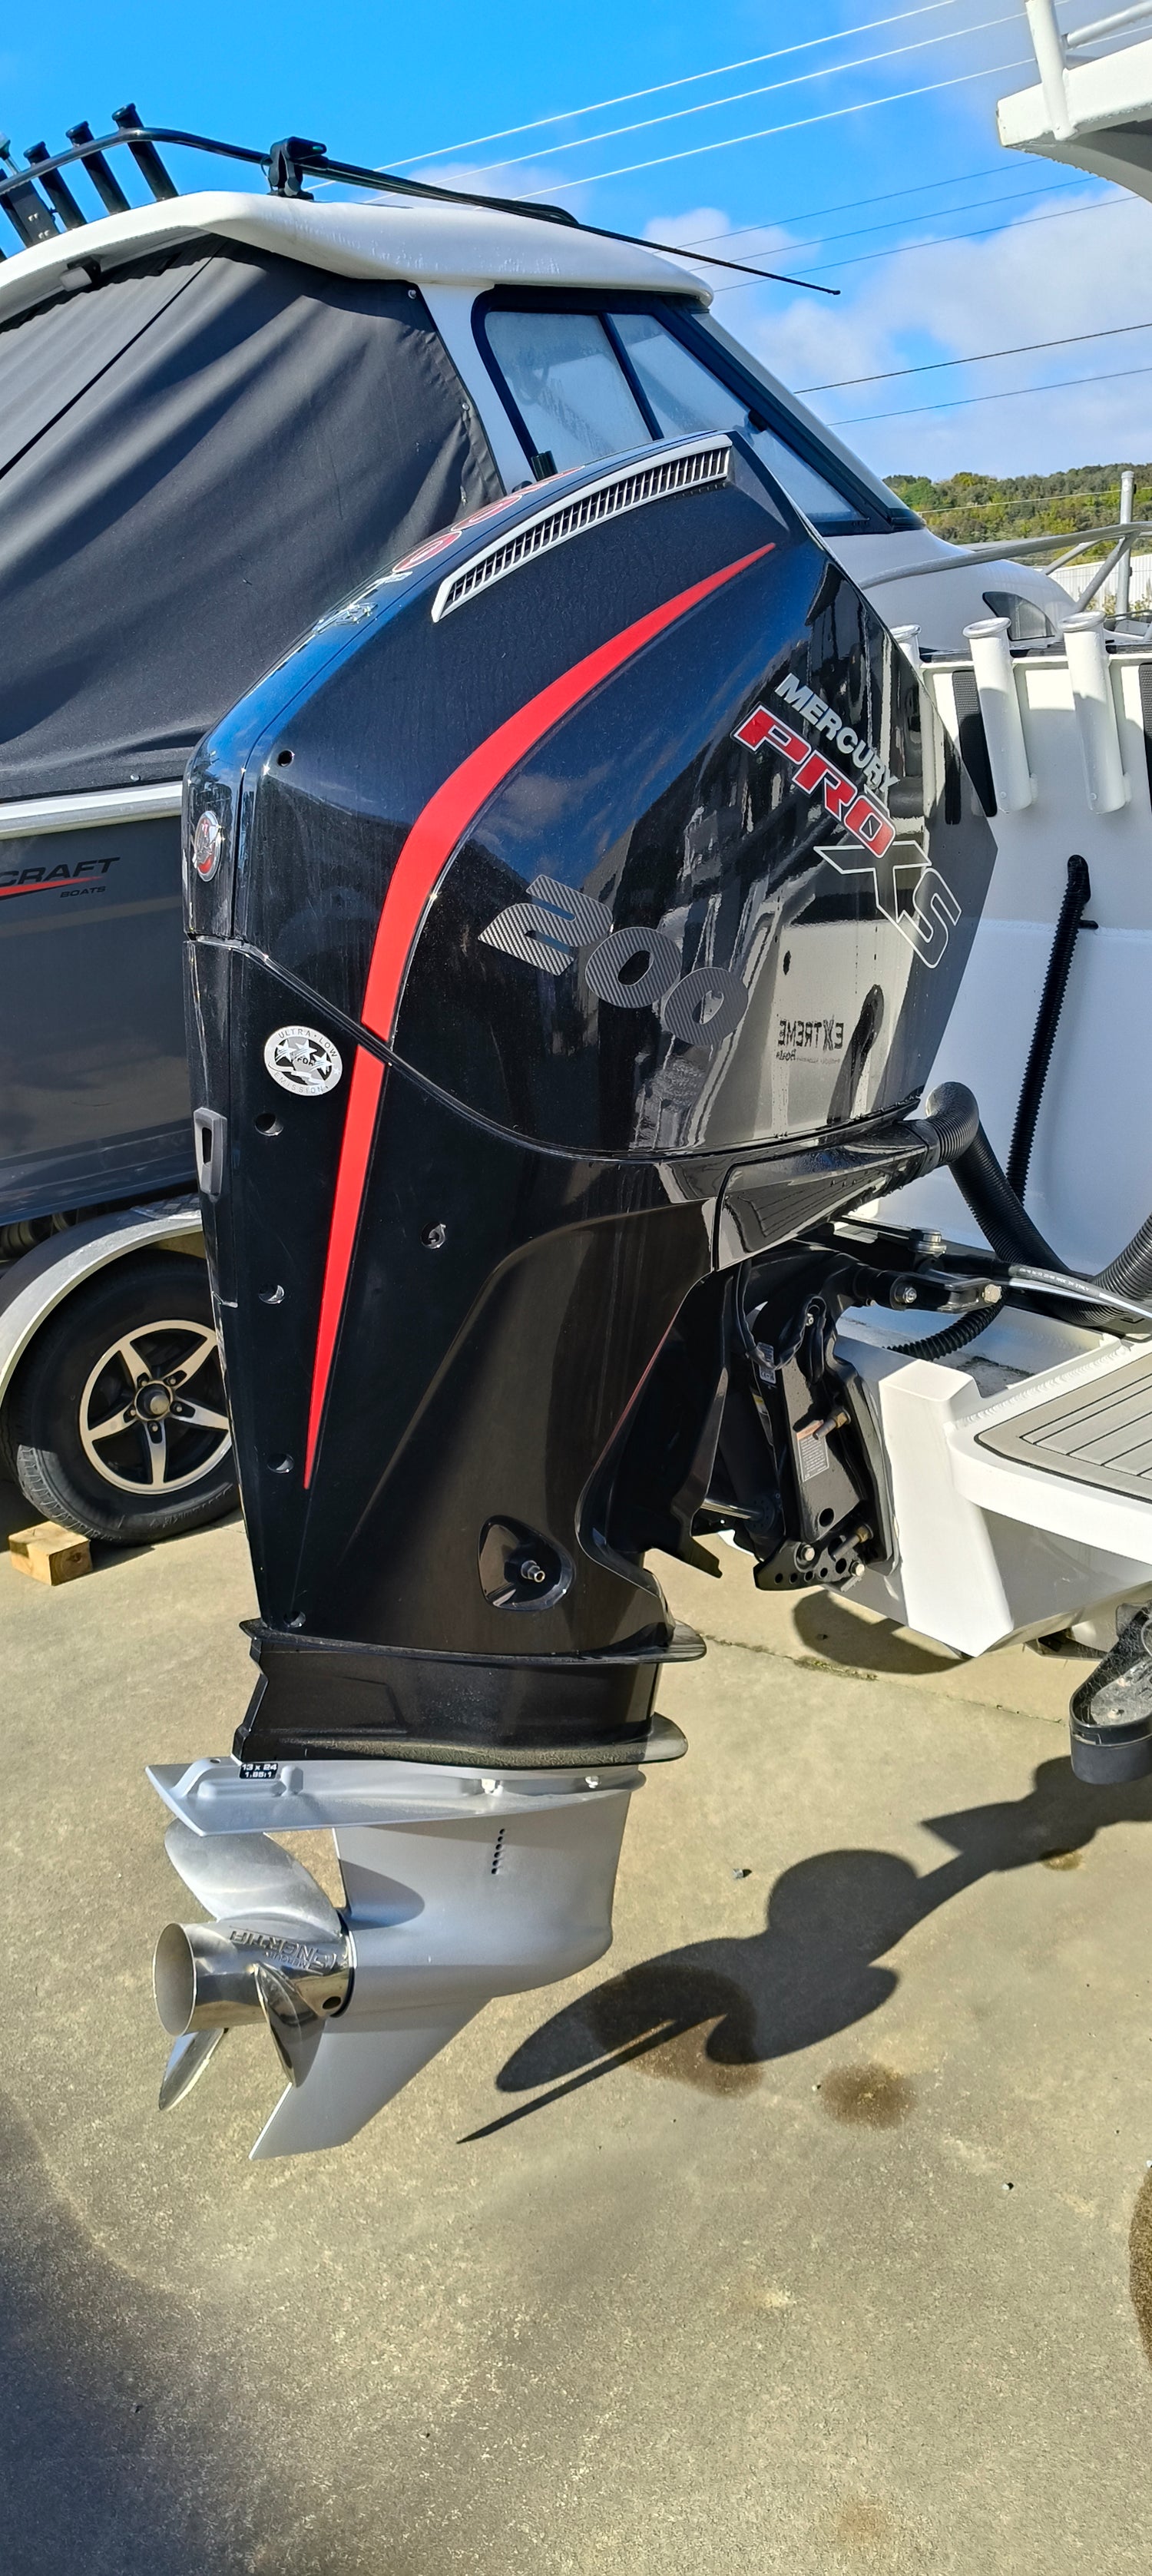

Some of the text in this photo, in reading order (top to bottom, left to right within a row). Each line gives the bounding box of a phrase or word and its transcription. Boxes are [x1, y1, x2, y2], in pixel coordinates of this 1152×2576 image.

[774, 673, 900, 793] MERCURY
[732, 702, 897, 859] PRO
[60, 886, 106, 898] BOATS
[477, 874, 749, 1046] 200
[278, 1028, 338, 1058] ULTRA LOW
[273, 1071, 323, 1094] EMISSION
